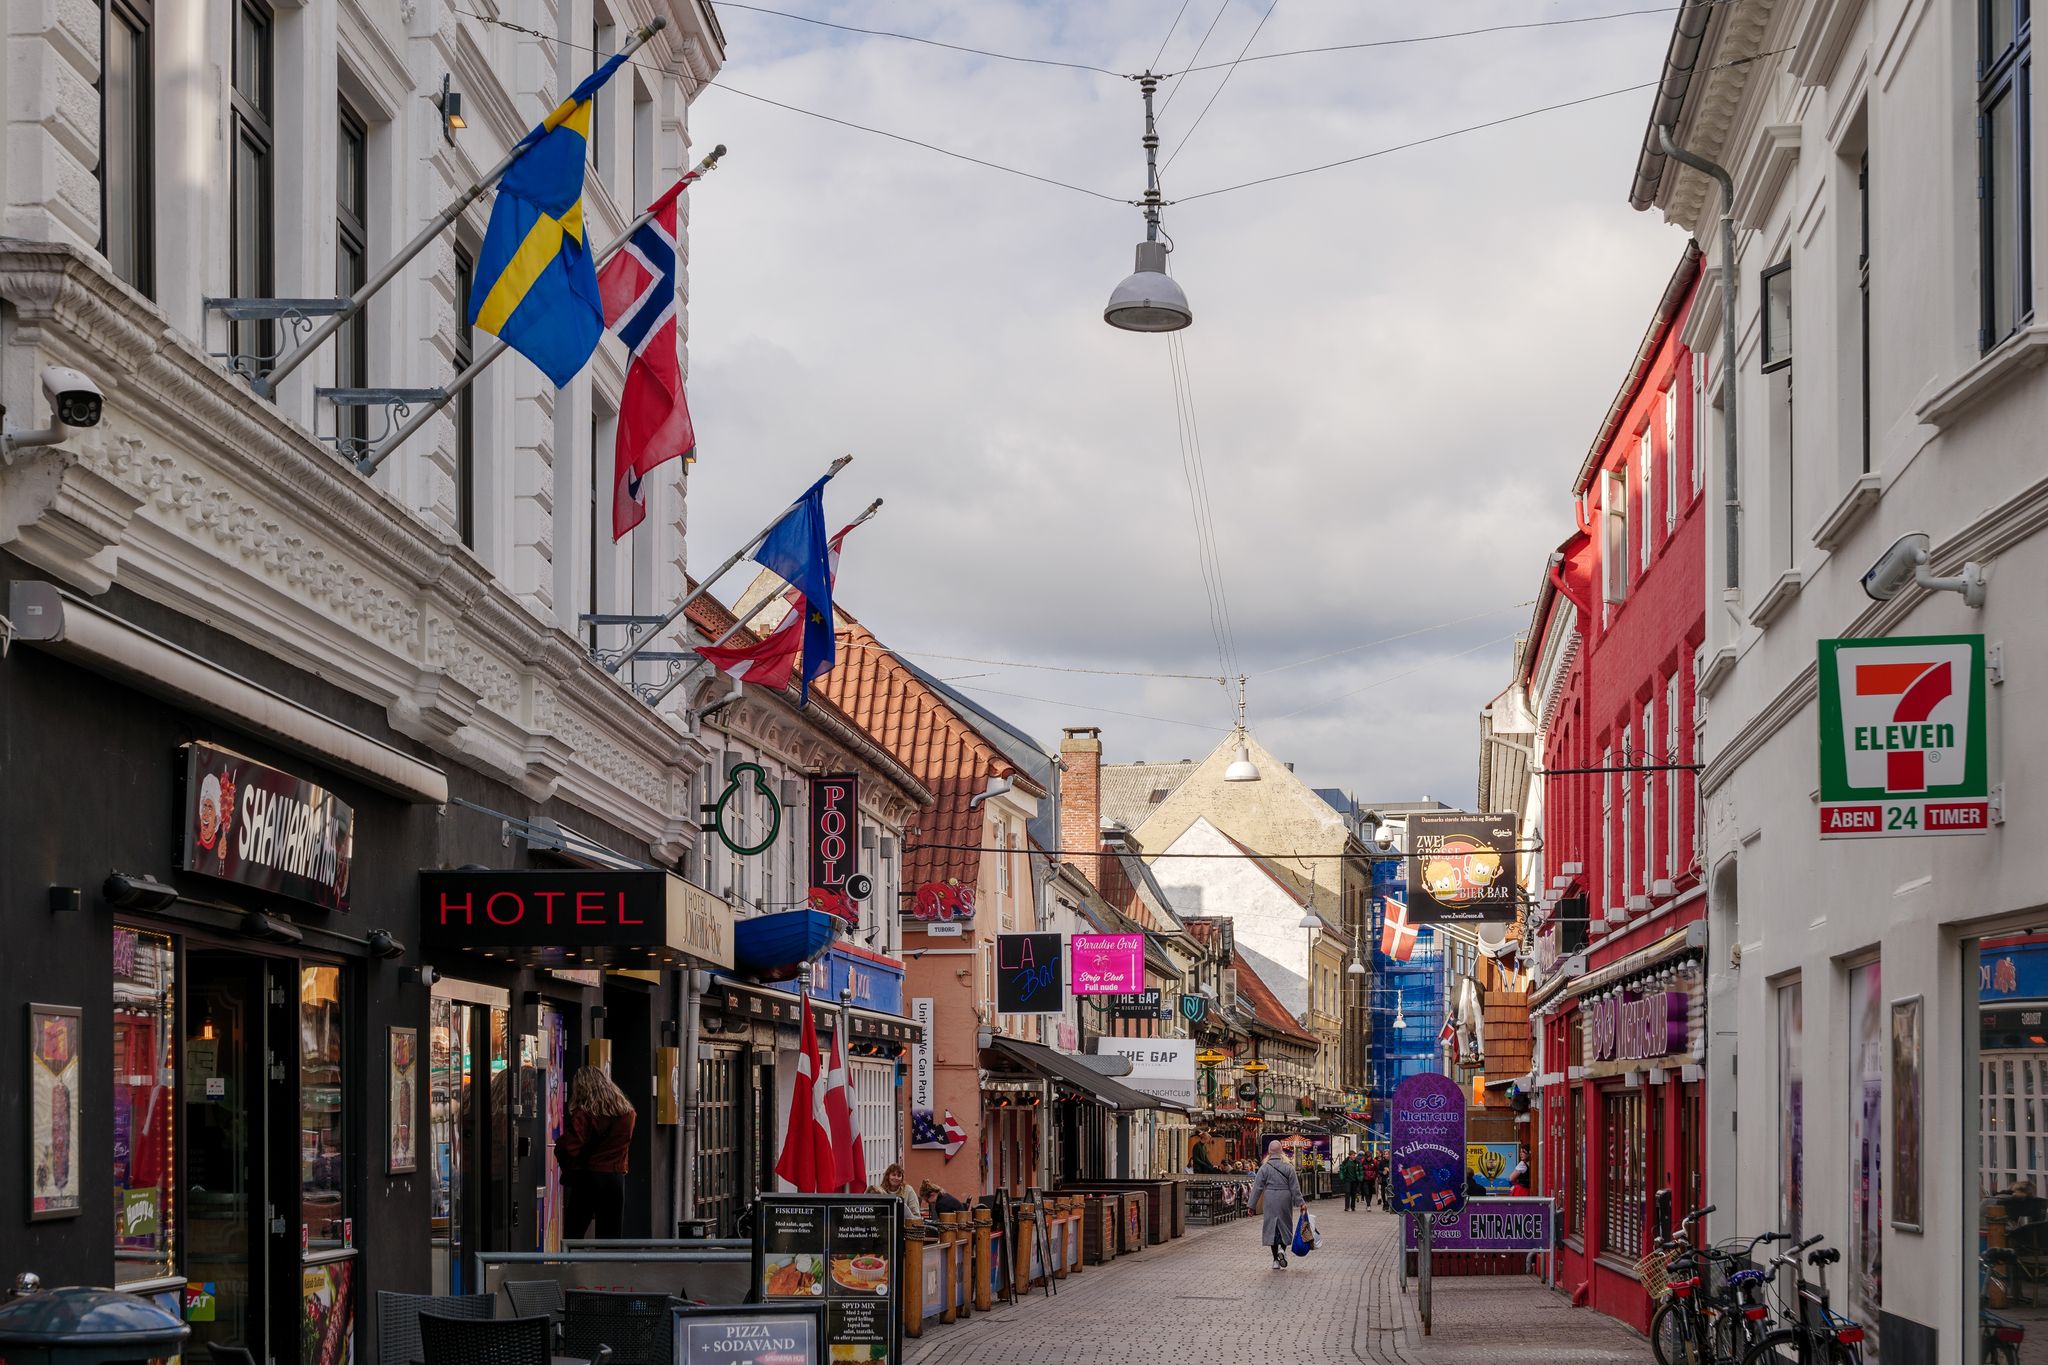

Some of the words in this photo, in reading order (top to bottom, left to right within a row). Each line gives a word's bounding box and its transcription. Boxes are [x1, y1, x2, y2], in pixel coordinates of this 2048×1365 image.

[1830, 809, 1874, 828] ÅBEN
[1887, 806, 1918, 830] 24
[1929, 808, 1980, 826] TIMER
[239, 784, 322, 881] SHAWARMA
[821, 785, 846, 885] POOL
[1416, 835, 1445, 848] ZWEI
[861, 882, 868, 892] 8
[1460, 888, 1485, 899] BIER
[1487, 886, 1509, 898] BAR
[440, 891, 644, 925] HOTEL
[1076, 937, 1115, 951] Paradise
[1116, 937, 1137, 950] Girls
[1000, 937, 1035, 970] LA
[1012, 956, 1059, 1002] Bar
[1079, 971, 1101, 983] Strip
[1103, 971, 1125, 982] Club
[1085, 983, 1099, 991] Full
[1100, 983, 1119, 991] nude
[1138, 992, 1159, 1004] GAP
[1150, 1051, 1178, 1063] GAP
[918, 1058, 927, 1079] Can
[916, 1080, 927, 1106] Party
[1152, 1089, 1191, 1097] NIGHTCLUB
[1394, 1140, 1460, 1161] Välkommen
[775, 1207, 815, 1215] FISKEFILET
[1469, 1213, 1543, 1240] ENTRANCE
[726, 1325, 770, 1338] PIZZA
[701, 1344, 710, 1352] +
[713, 1338, 796, 1352] SODAVAND
